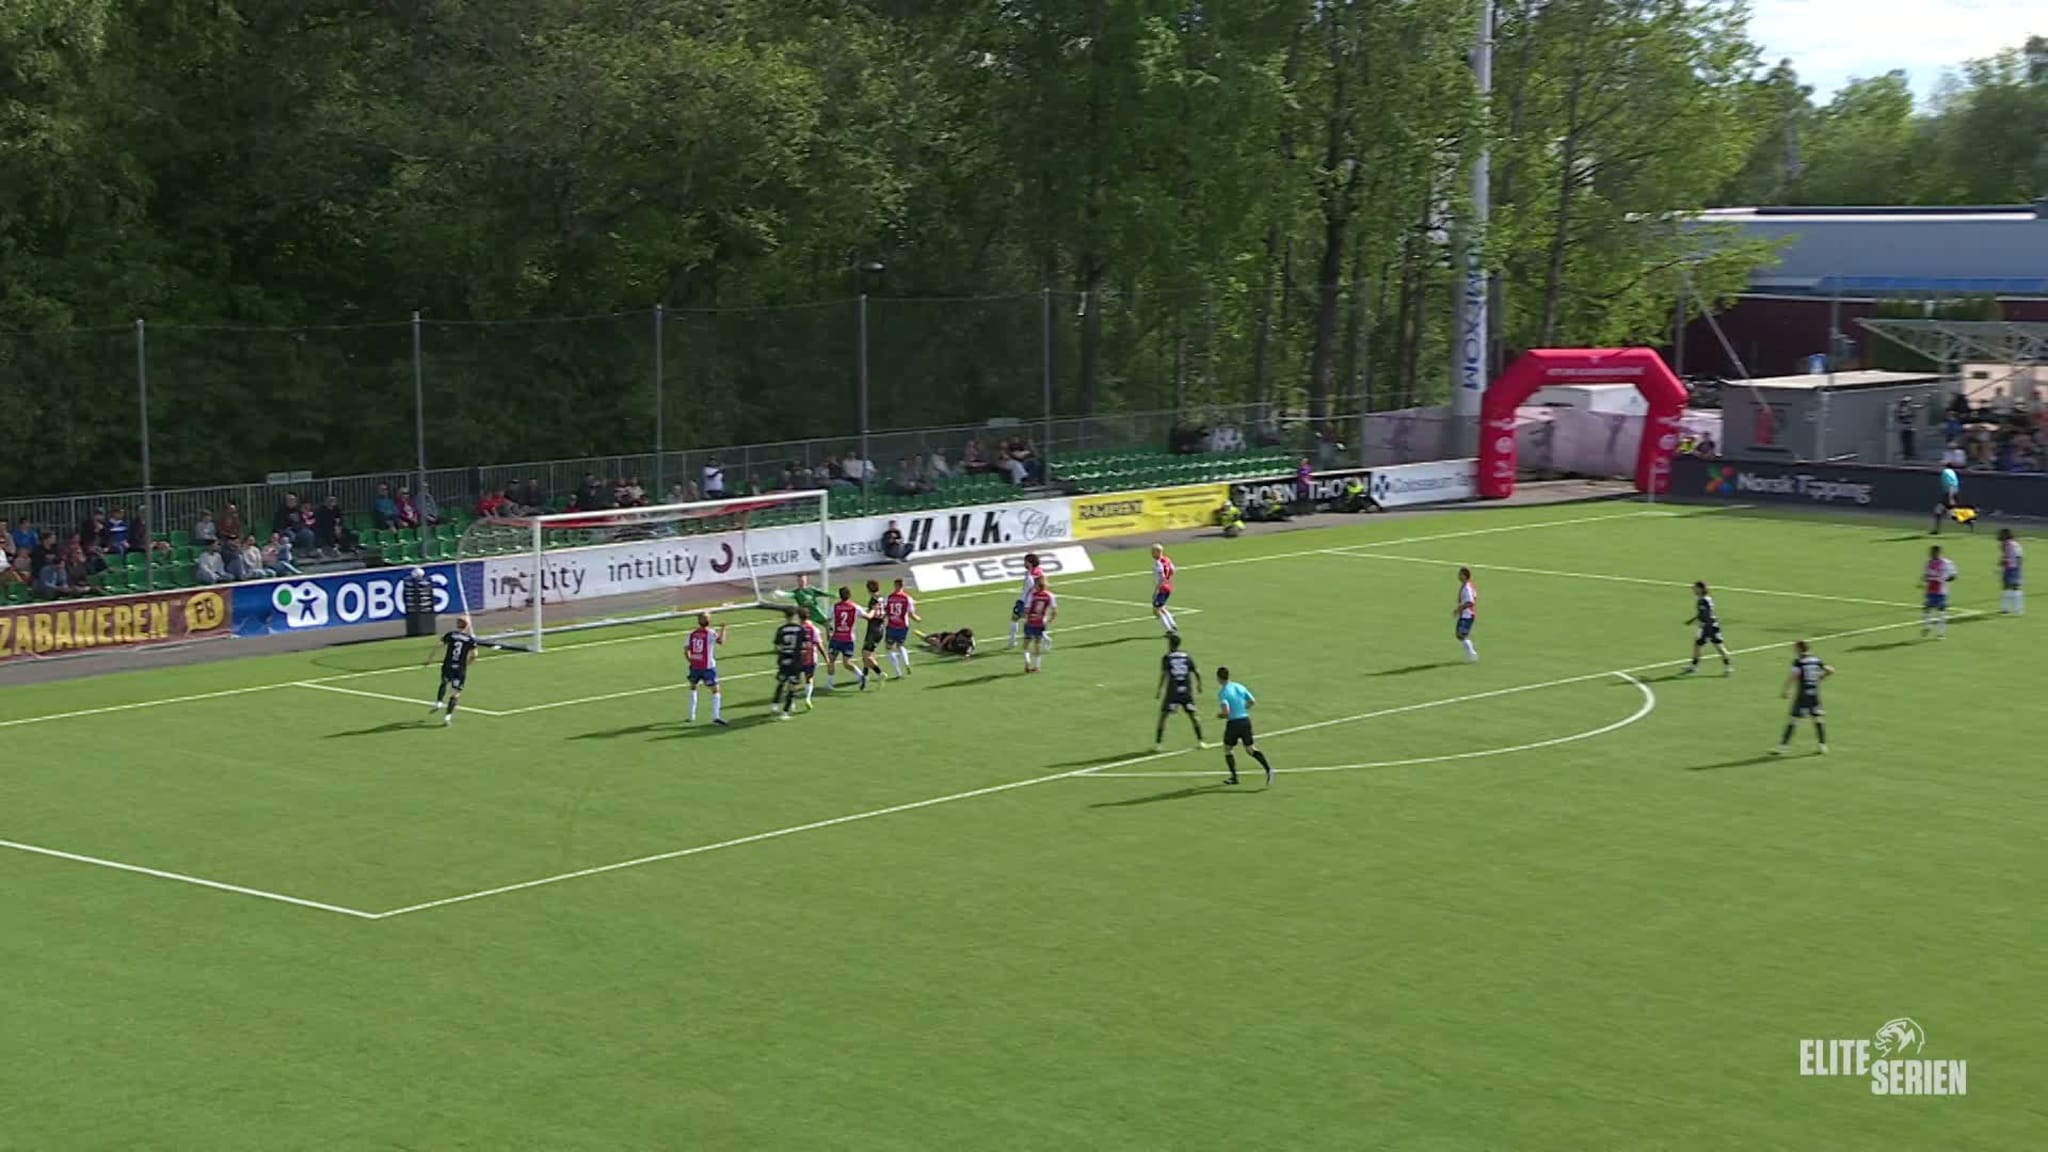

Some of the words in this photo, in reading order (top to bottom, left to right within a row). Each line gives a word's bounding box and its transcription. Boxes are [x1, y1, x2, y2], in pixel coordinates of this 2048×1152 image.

[1308, 477, 1368, 499] THO
[1737, 473, 1794, 492] Norsk
[1796, 475, 1873, 503] Tipping
[608, 549, 698, 582] intility
[737, 550, 799, 569] MERKUR
[943, 553, 1063, 583] TESS
